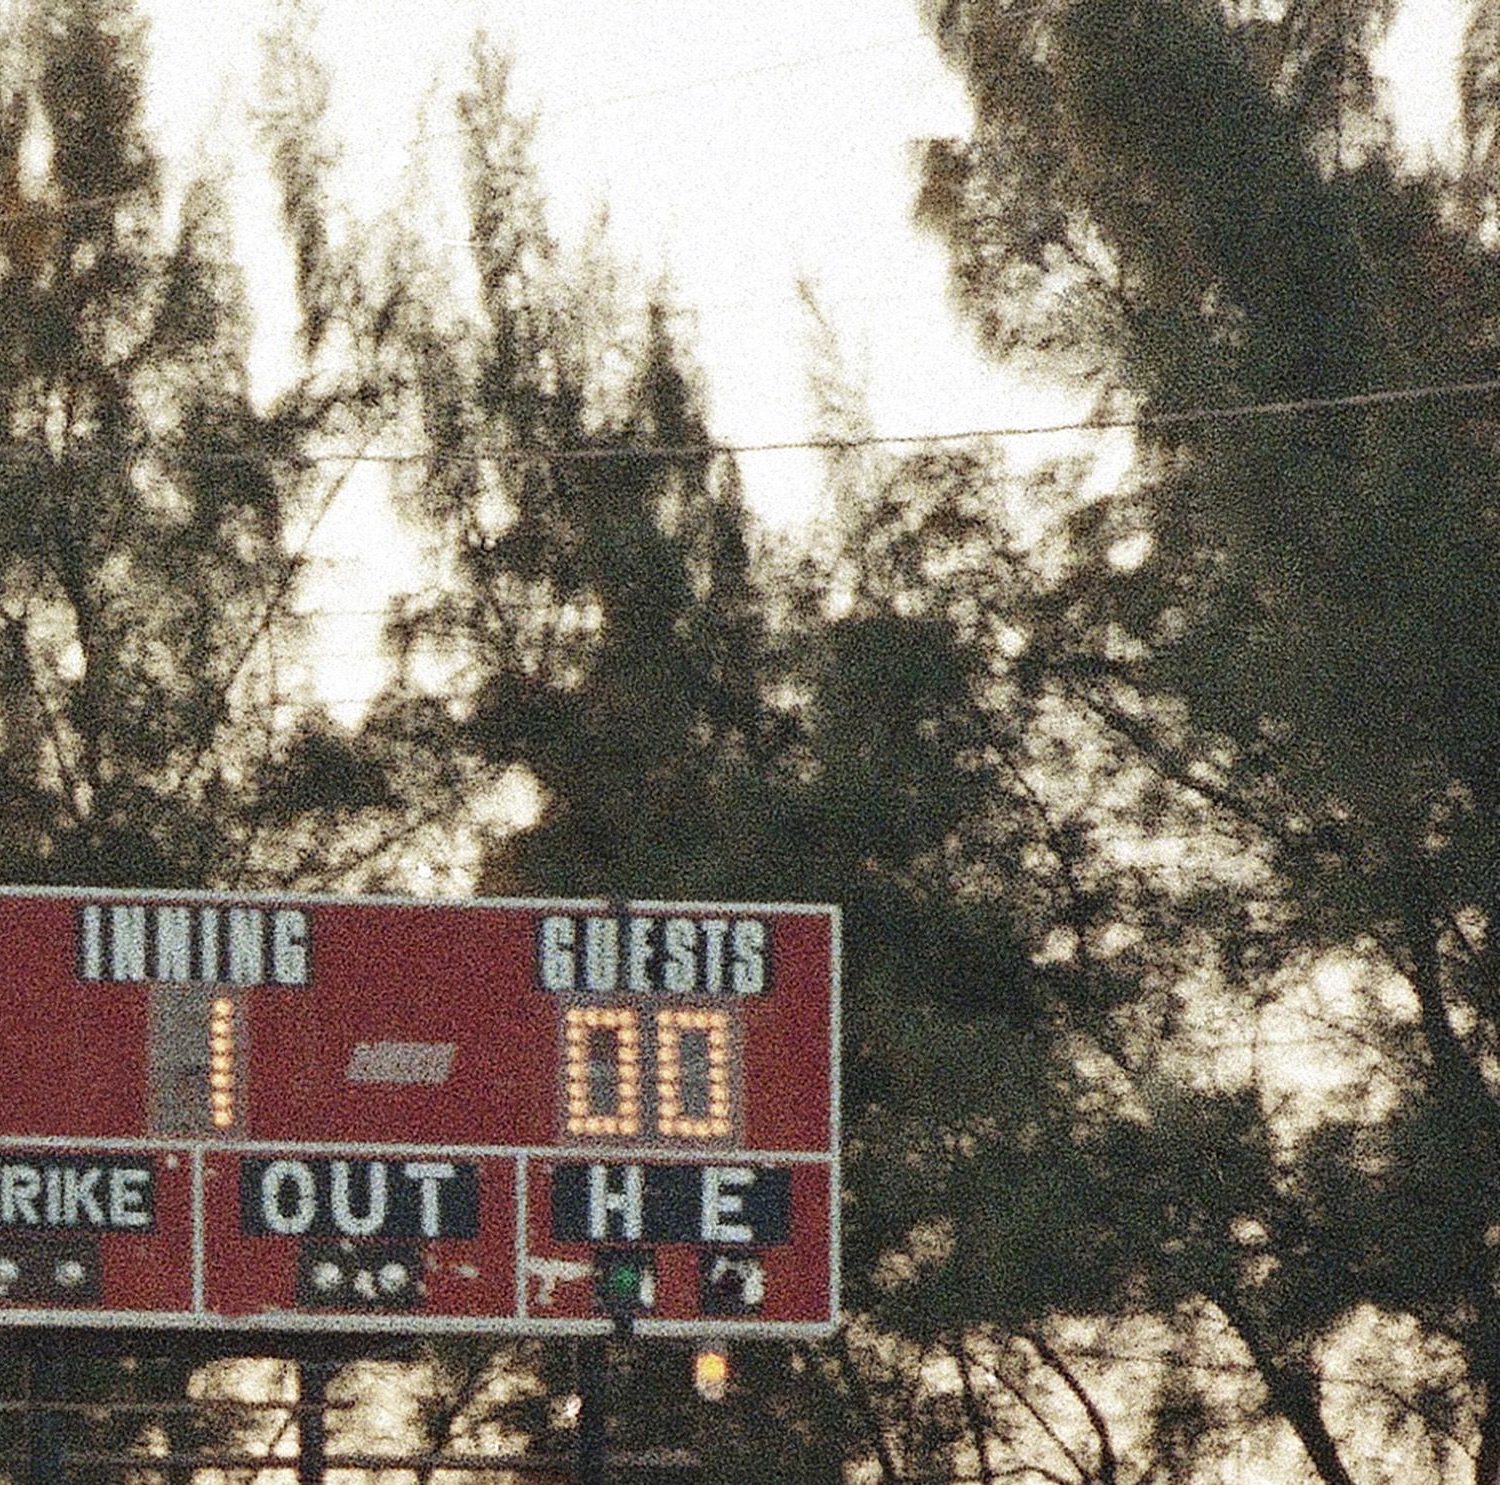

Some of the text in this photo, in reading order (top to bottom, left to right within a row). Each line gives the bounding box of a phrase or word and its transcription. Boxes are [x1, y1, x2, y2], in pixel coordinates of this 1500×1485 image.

[82, 905, 307, 985] INNING
[541, 916, 764, 994] GUESTS
[209, 997, 236, 1128] 1
[565, 1006, 730, 1138] 00
[260, 1160, 455, 1237] OUT
[586, 1165, 754, 1242] H E
